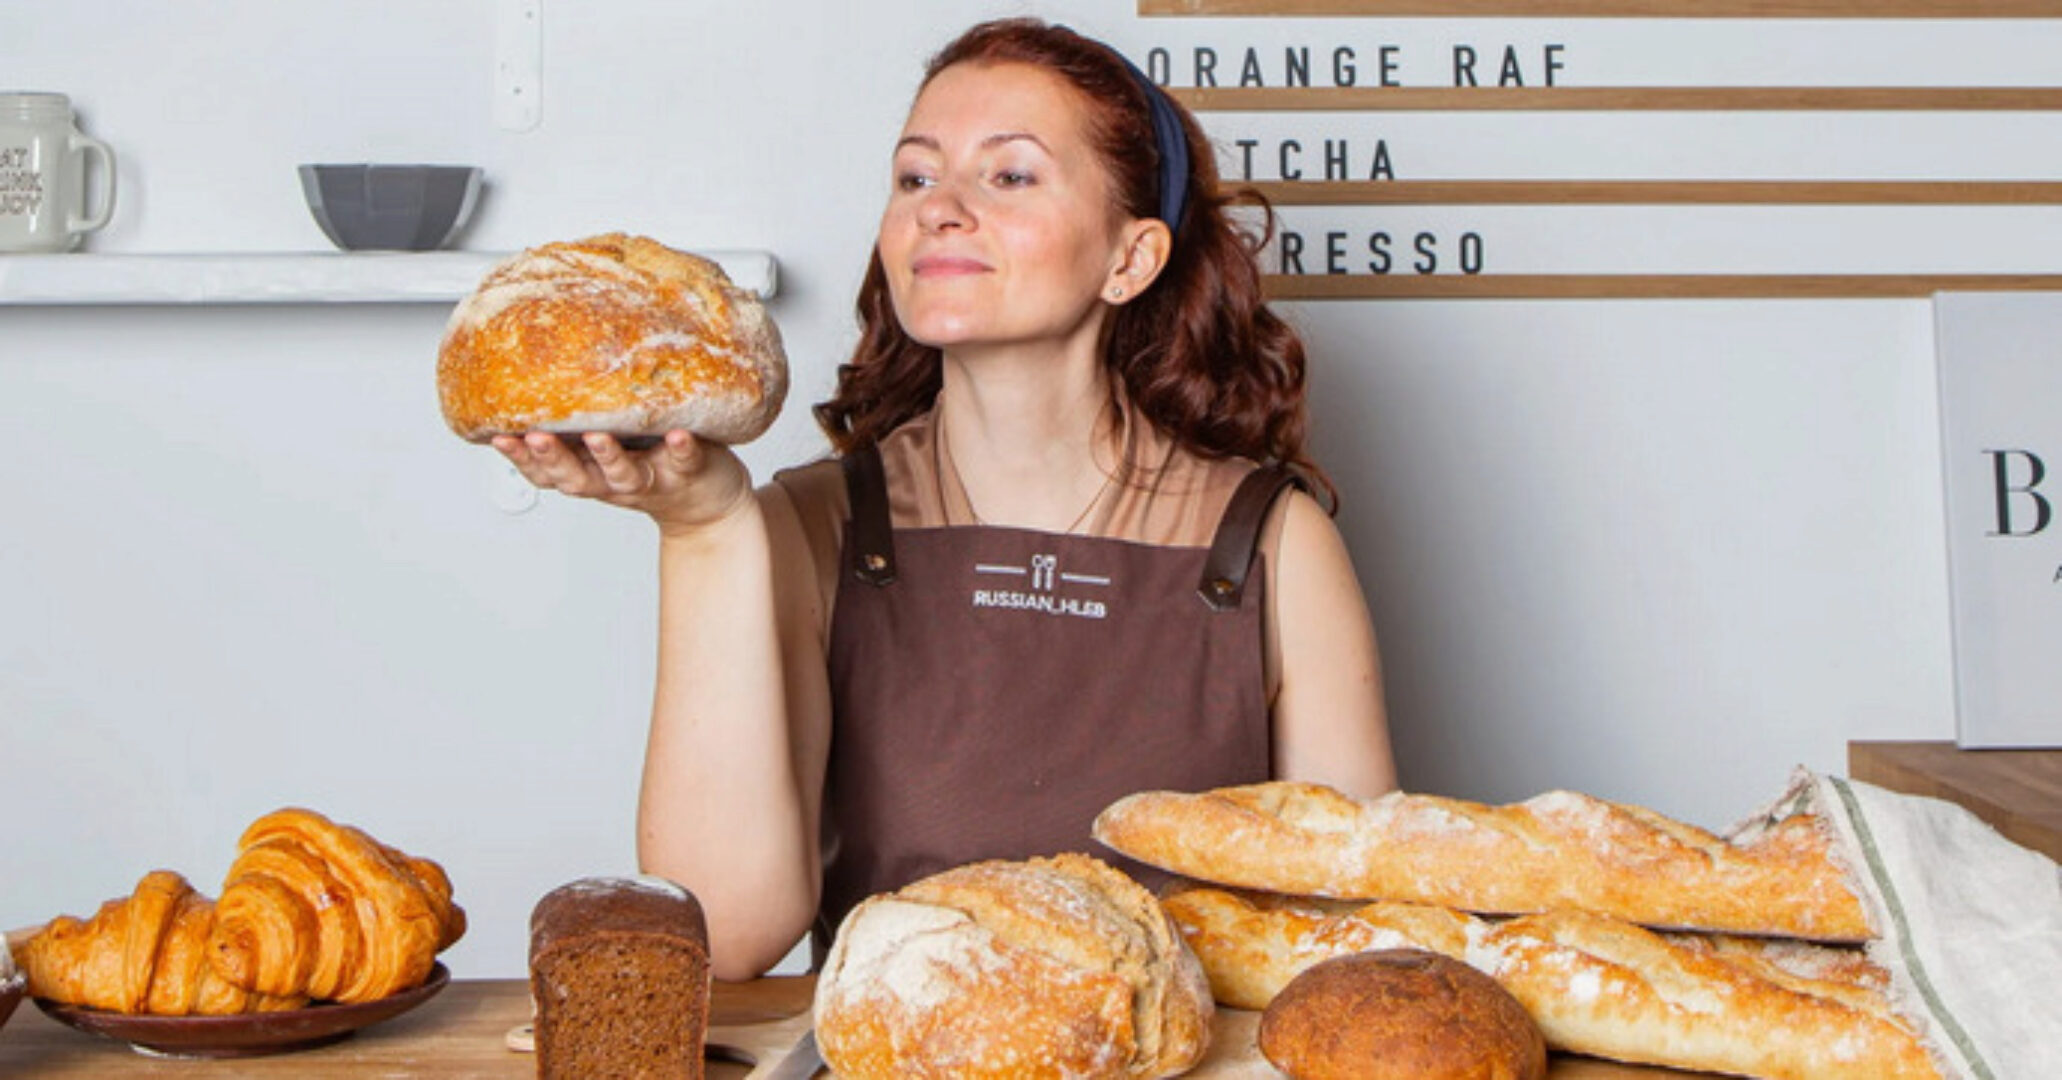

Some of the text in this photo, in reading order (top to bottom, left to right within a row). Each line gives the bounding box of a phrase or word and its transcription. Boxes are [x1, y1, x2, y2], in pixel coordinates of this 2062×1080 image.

[1148, 44, 1565, 87] ORANGE RAF
[1236, 139, 1395, 180] TCHA
[1983, 449, 2052, 537] B
